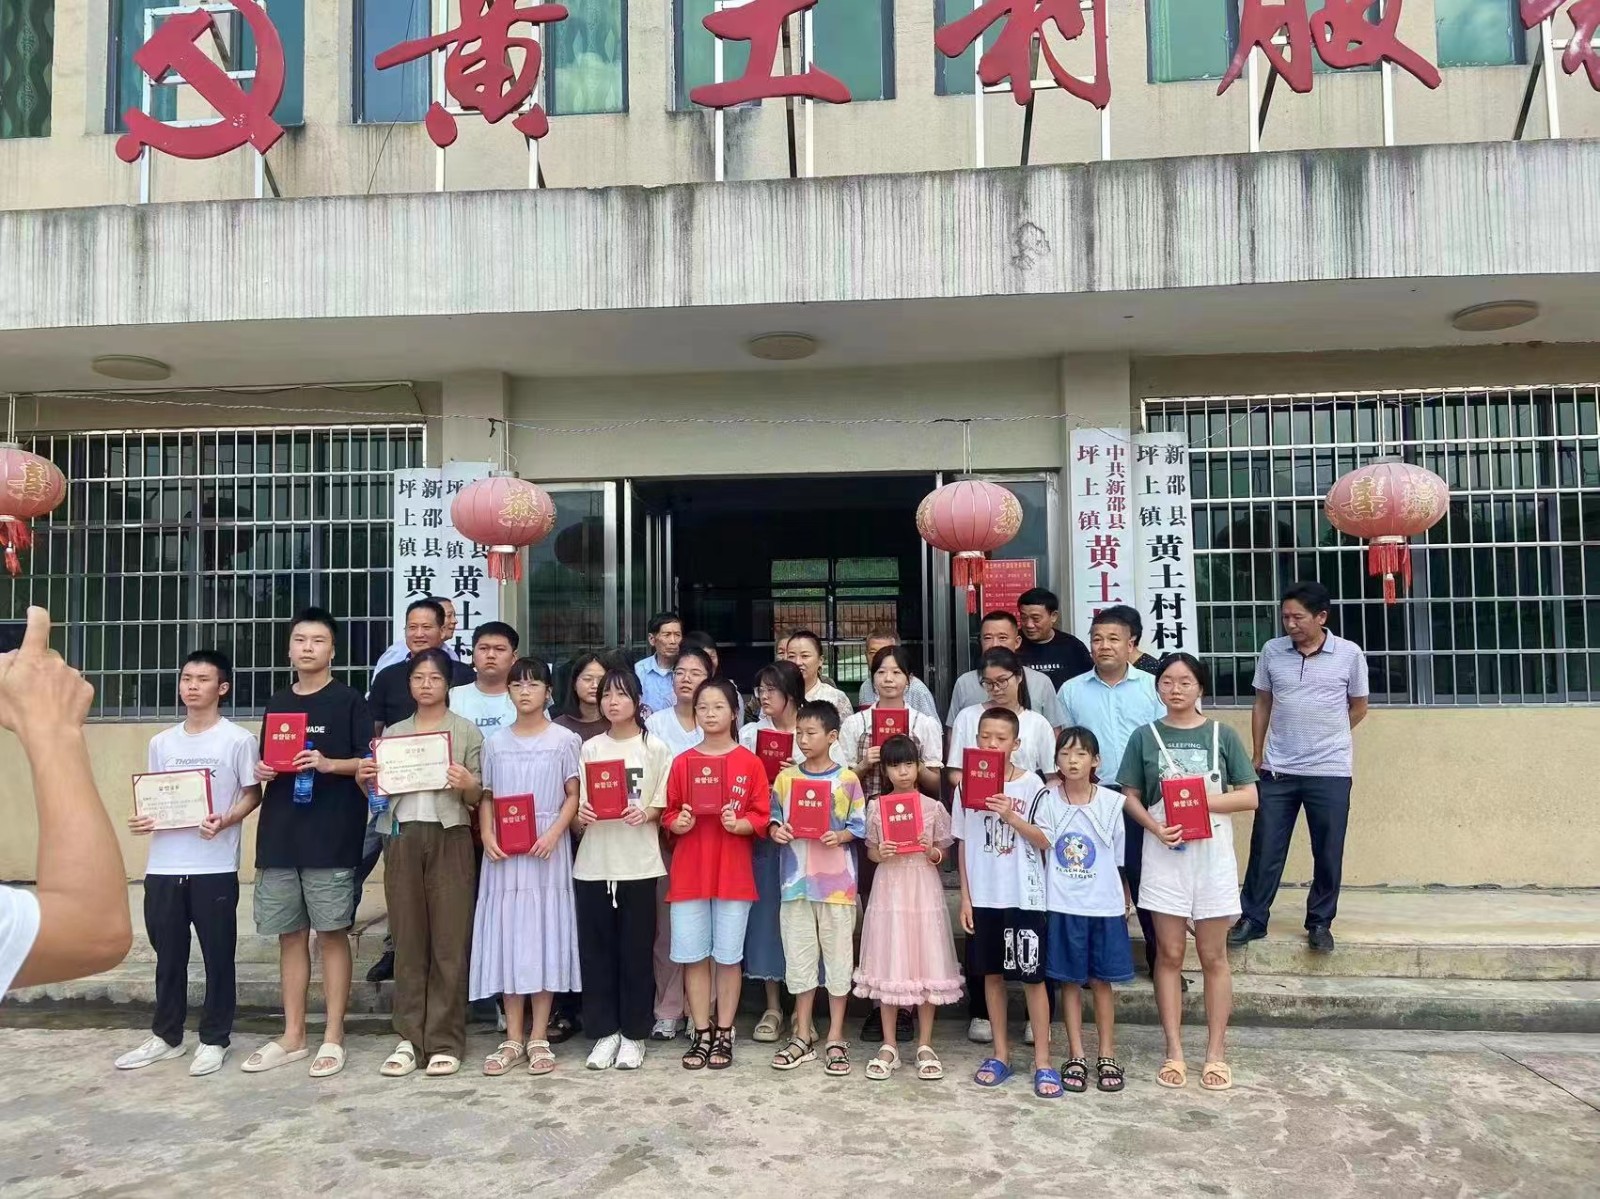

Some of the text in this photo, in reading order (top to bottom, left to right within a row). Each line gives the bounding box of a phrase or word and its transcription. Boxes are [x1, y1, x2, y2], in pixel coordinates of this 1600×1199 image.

[398, 478, 417, 558] 坪上镇
[421, 478, 443, 558] 新邵县
[446, 479, 465, 560] 坪镇
[1076, 444, 1101, 531] 坪上镇
[1105, 443, 1127, 530] 中共新邵县
[1136, 444, 1162, 527] 坪上镇
[1164, 443, 1188, 527] 新邵县
[1085, 534, 1123, 619] 黄土
[1145, 534, 1188, 660] 黄土村村
[732, 785, 747, 798] my
[1003, 928, 1040, 977] 10
